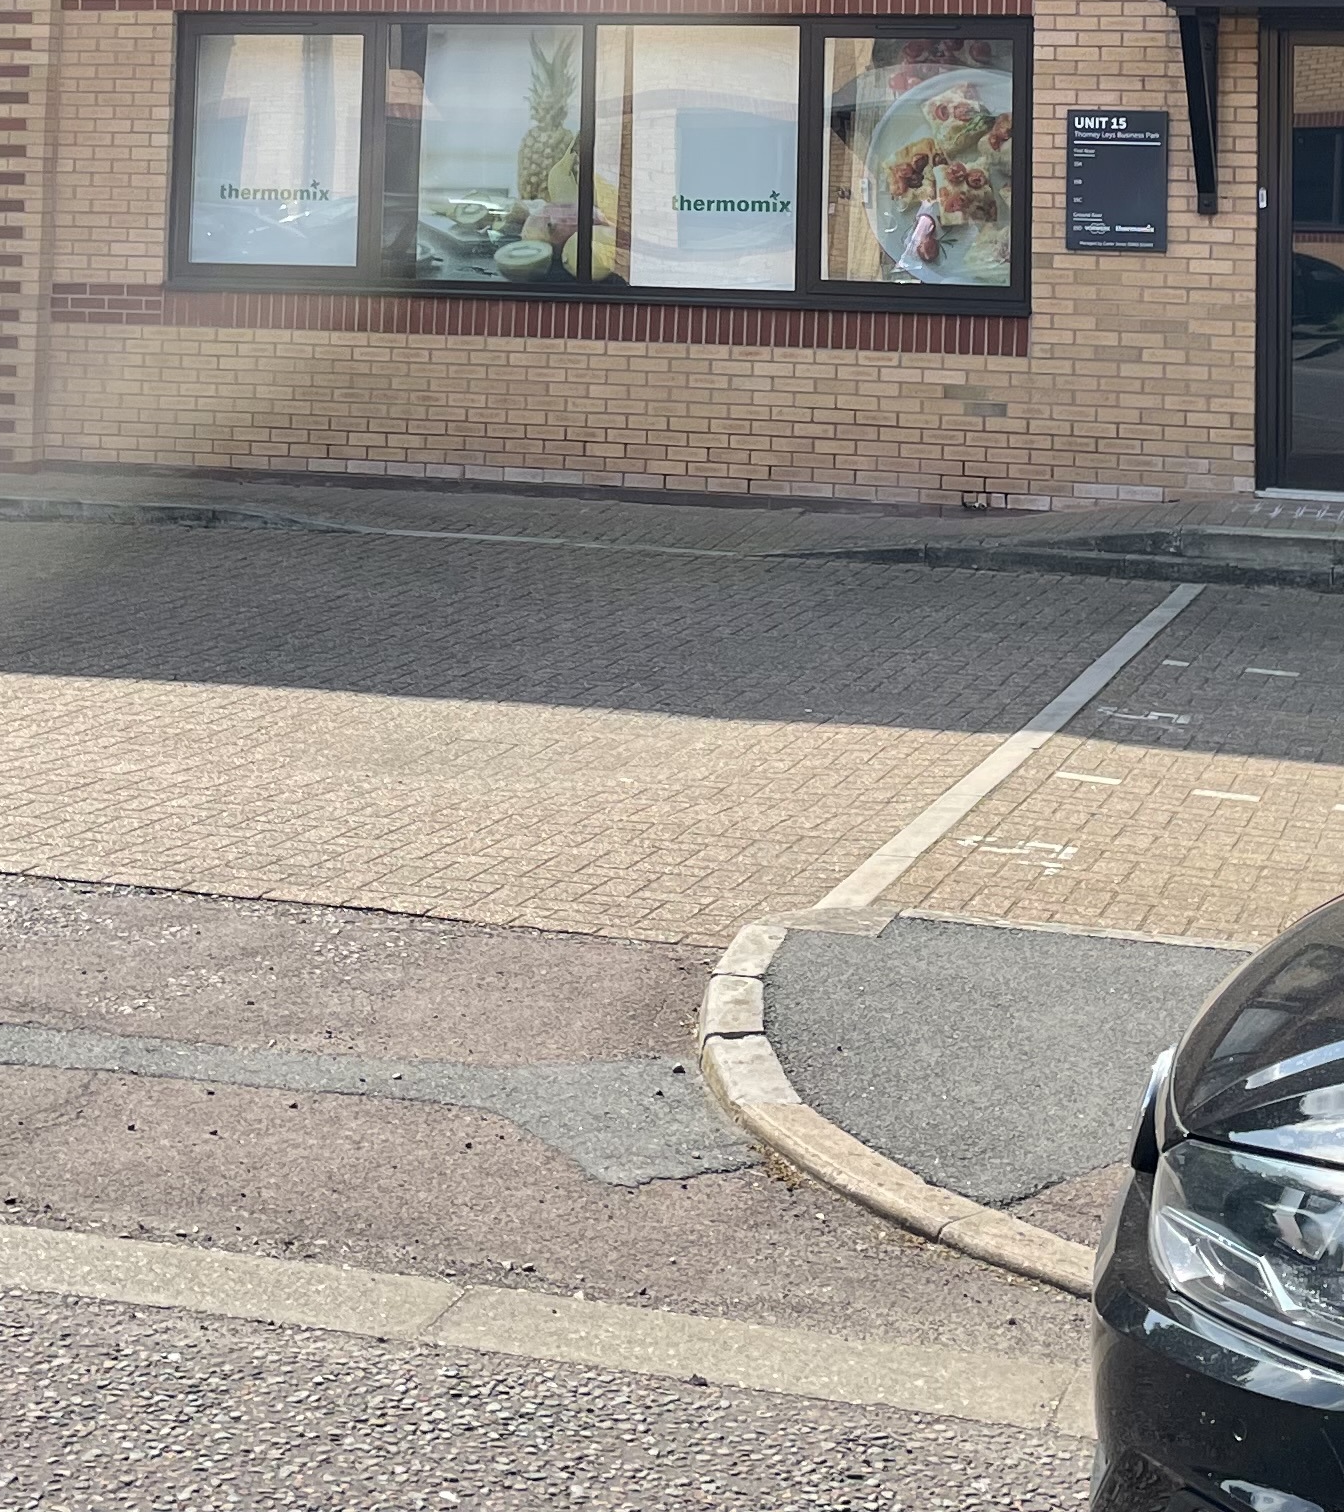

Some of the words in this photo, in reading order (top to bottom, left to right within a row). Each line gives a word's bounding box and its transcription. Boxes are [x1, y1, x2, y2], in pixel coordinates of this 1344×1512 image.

[1074, 116, 1109, 129] UNIT
[1110, 117, 1127, 130] 15
[1074, 130, 1101, 139] Thorney
[1101, 131, 1116, 139] Leys
[1116, 131, 1145, 139] Business
[1145, 131, 1160, 139] Park
[220, 179, 330, 201] thermomix
[672, 190, 791, 213] thermomix
